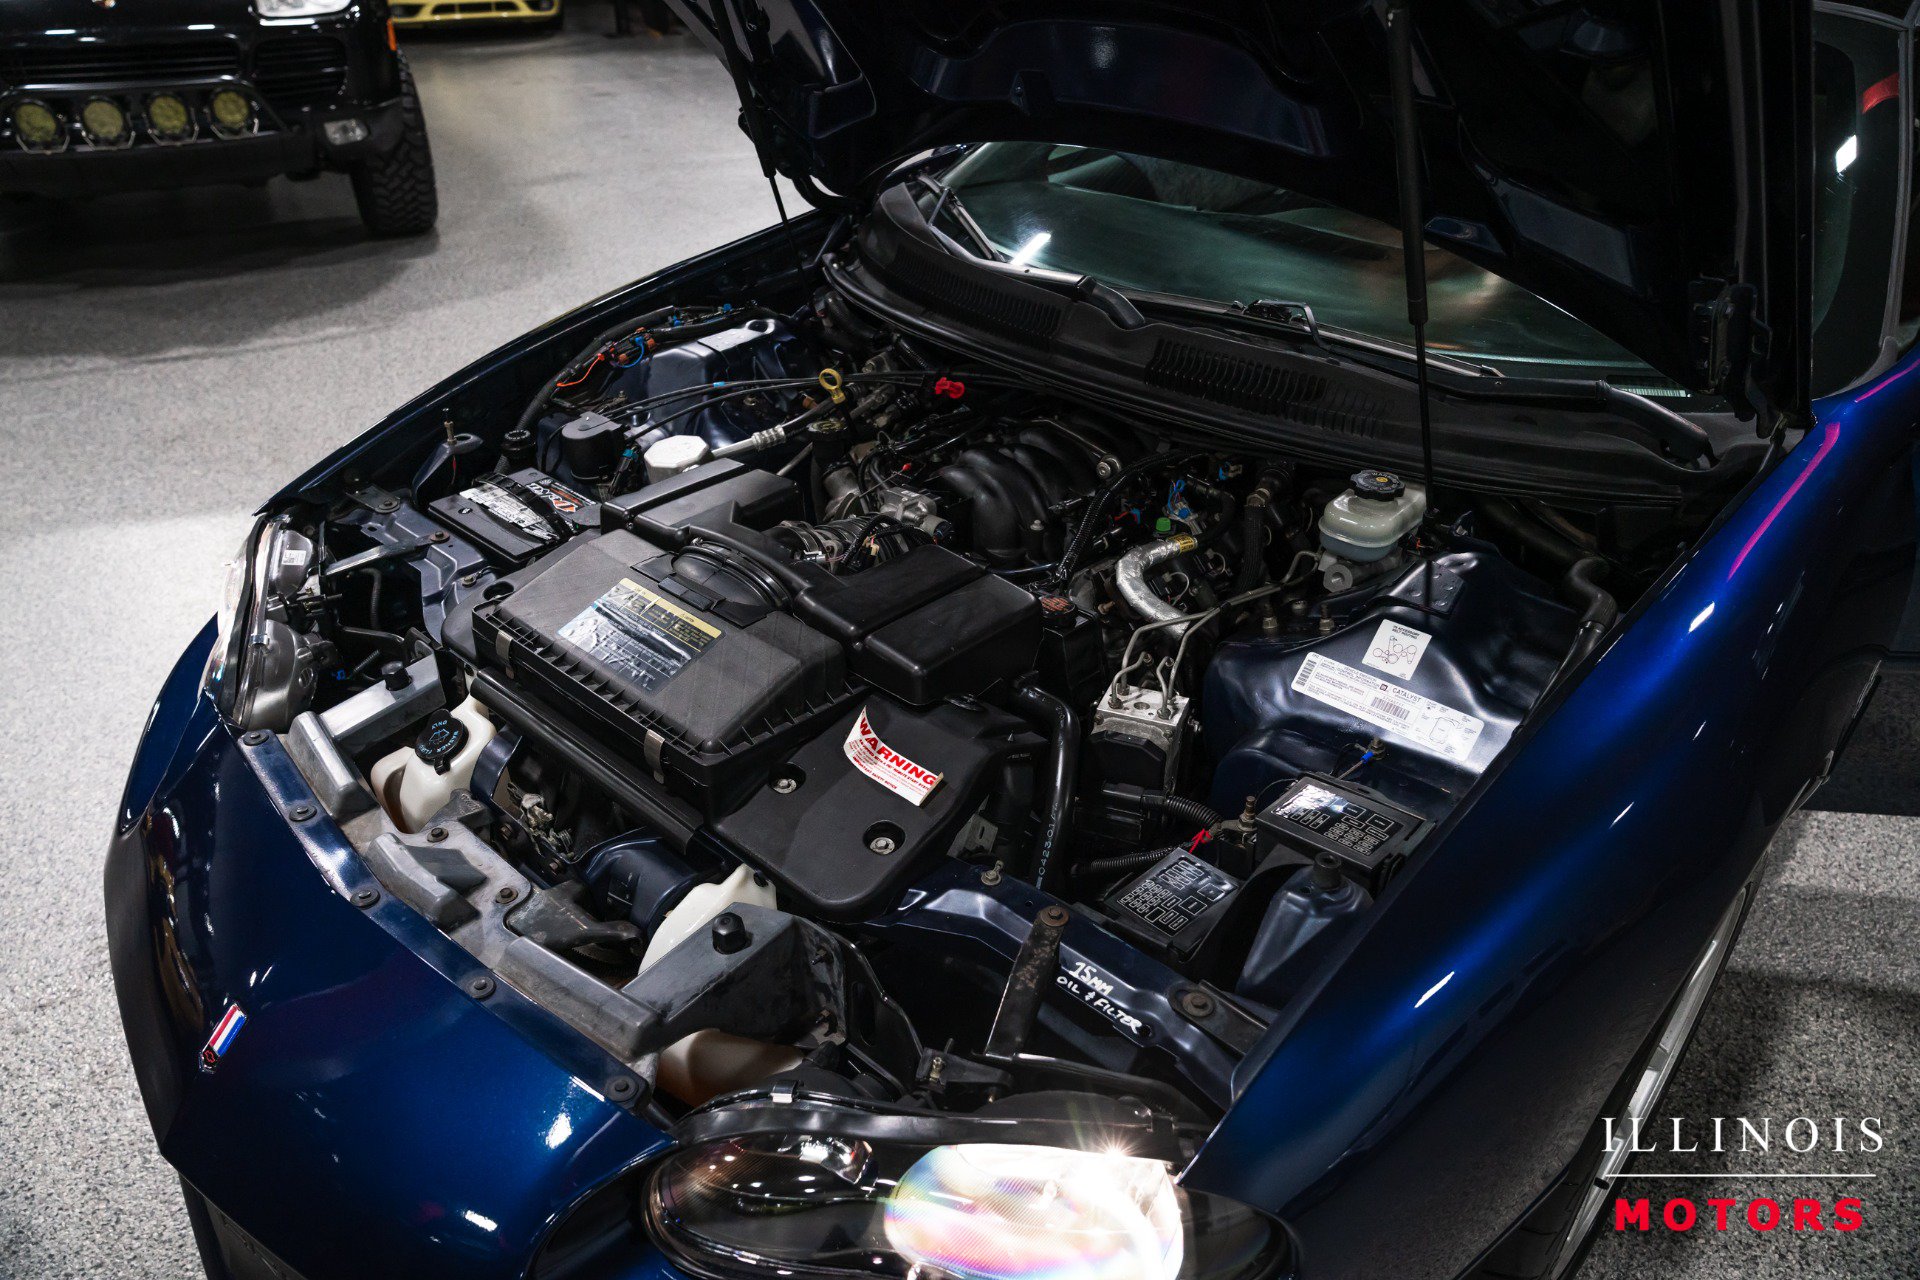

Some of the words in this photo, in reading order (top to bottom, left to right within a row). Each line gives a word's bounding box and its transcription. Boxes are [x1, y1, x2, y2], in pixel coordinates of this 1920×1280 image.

[1392, 687, 1421, 702] CATALYST
[431, 719, 448, 730] ONLY
[860, 717, 937, 786] WARNING
[1068, 961, 1114, 996] 15MM
[1056, 976, 1080, 994] OIL
[1093, 998, 1143, 1034] FILTER
